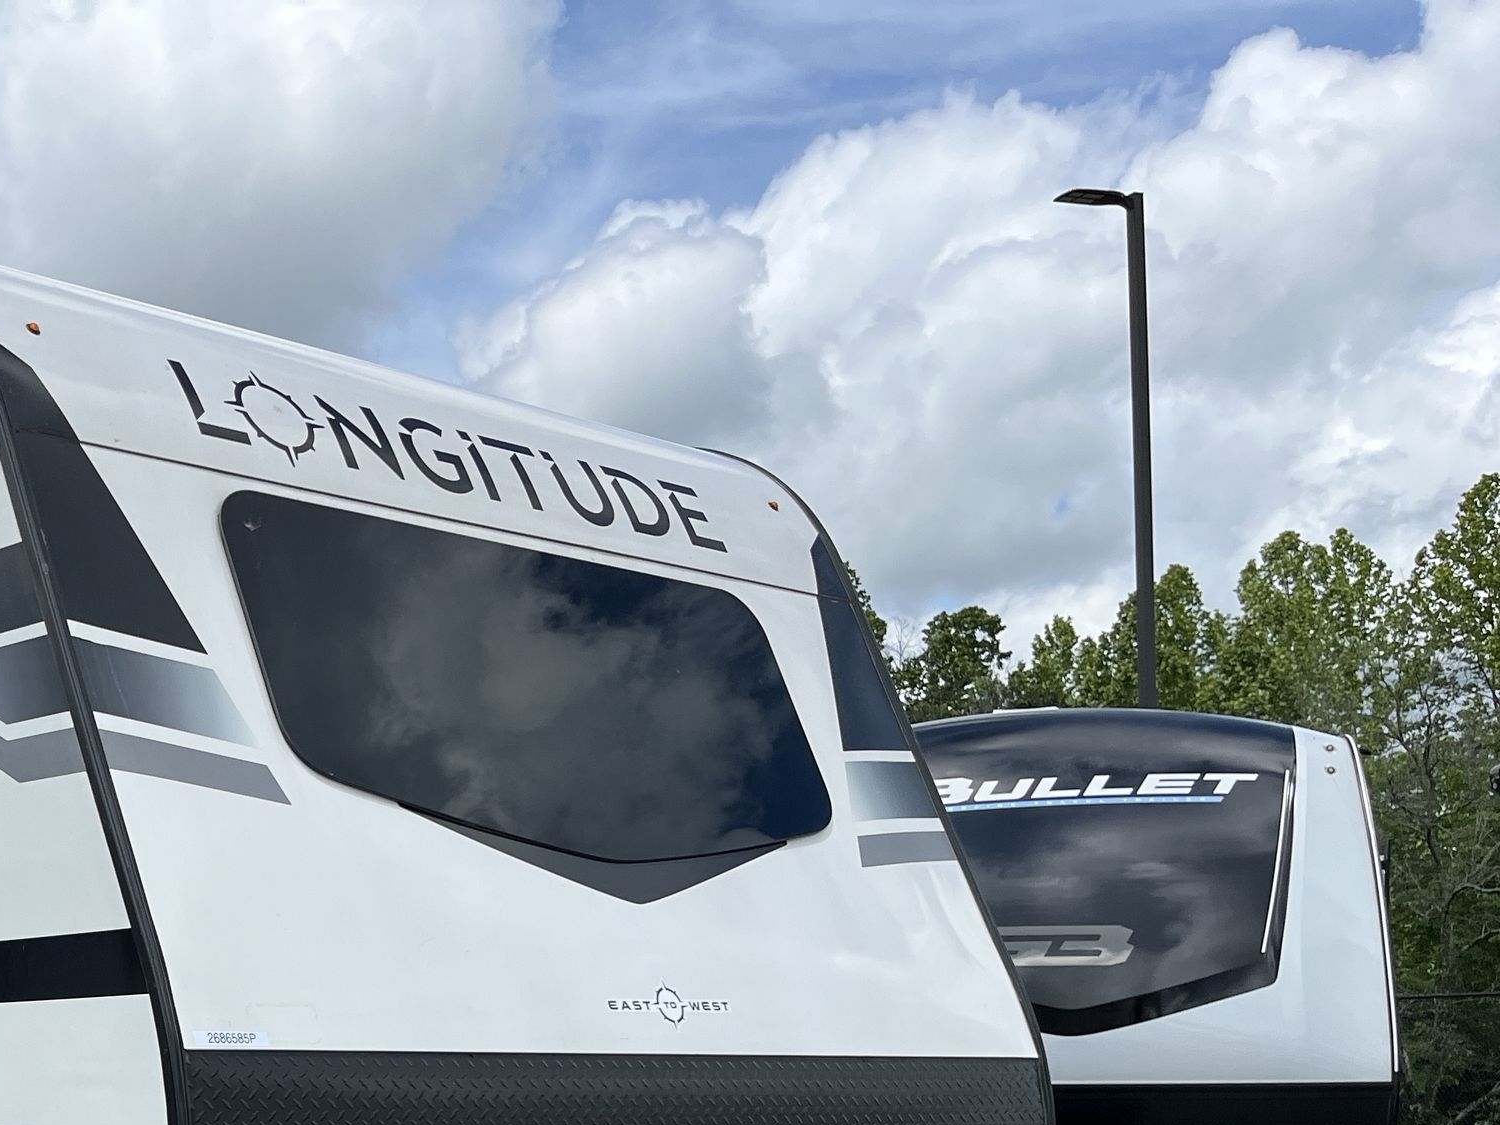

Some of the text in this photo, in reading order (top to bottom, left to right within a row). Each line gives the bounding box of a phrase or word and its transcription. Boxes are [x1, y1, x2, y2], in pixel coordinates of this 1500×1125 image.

[167, 359, 728, 554] LONGITUDE
[934, 772, 1259, 804] BULLET
[607, 1000, 729, 1012] EAST TO WEST
[207, 1032, 257, 1044] 2686585P
